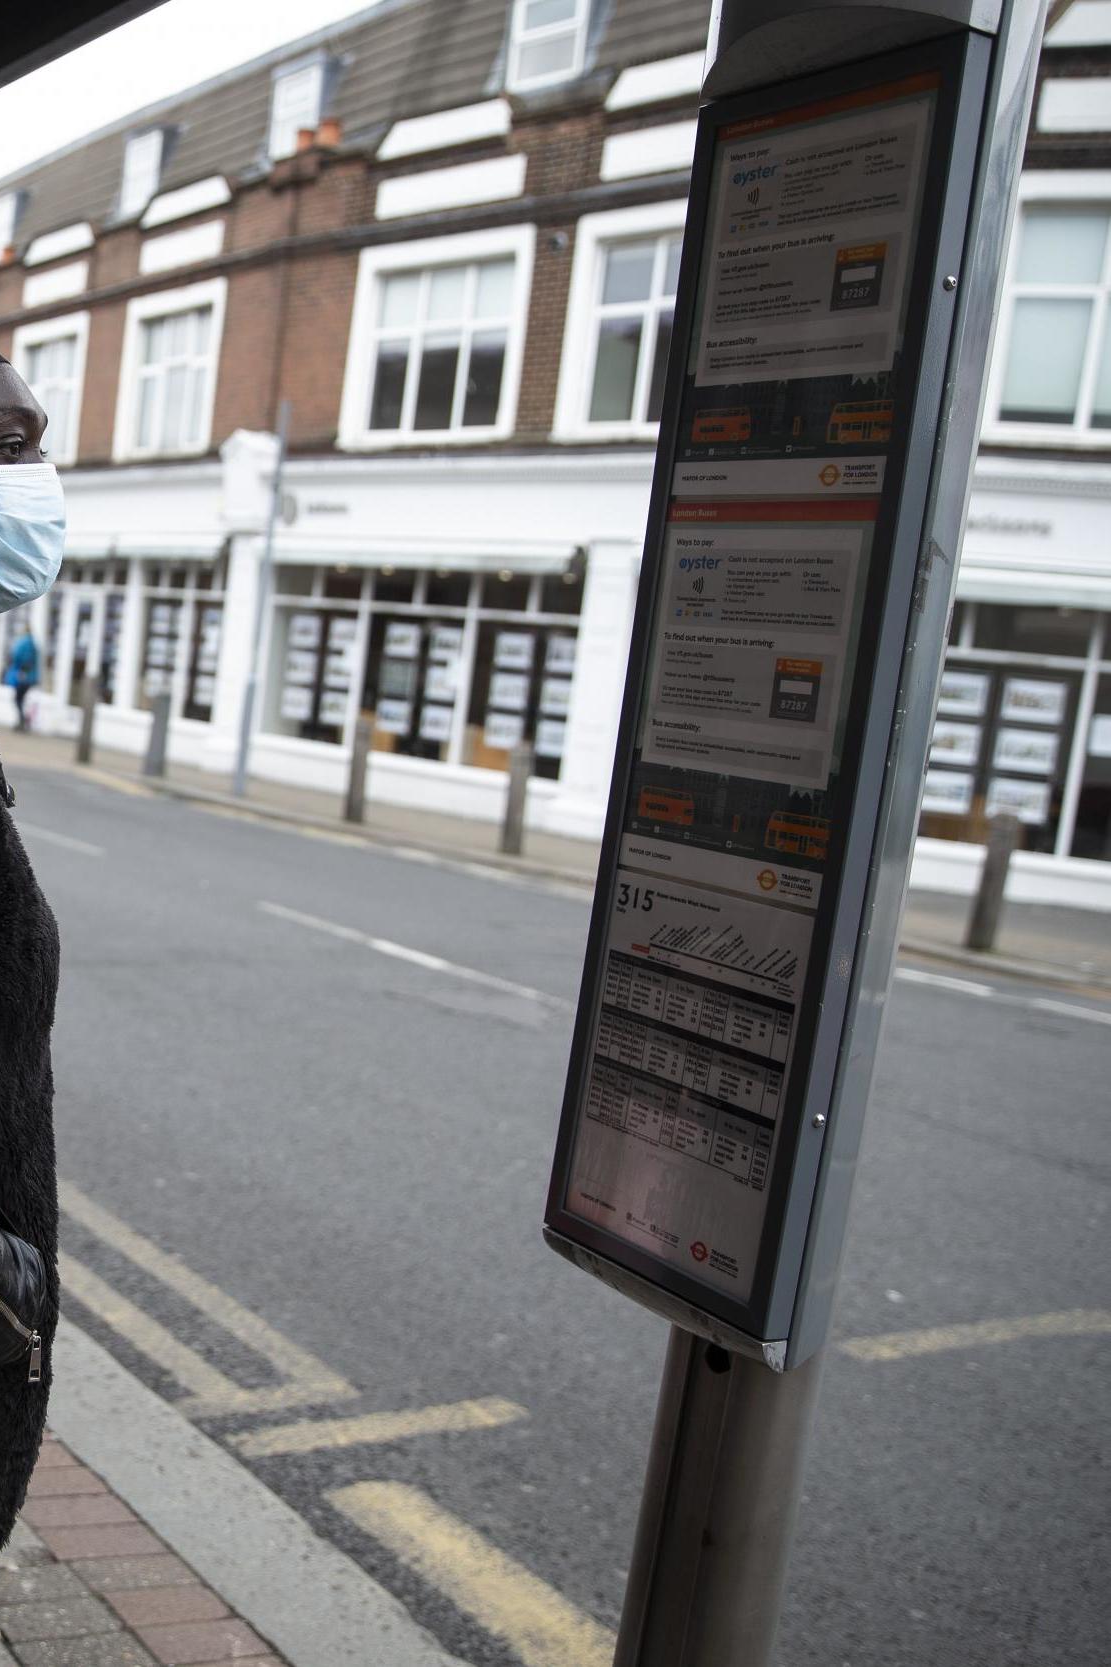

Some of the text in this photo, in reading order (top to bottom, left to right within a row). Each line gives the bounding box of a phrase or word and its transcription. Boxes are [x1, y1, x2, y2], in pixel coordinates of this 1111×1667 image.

[730, 150, 746, 162] Ways
[733, 163, 779, 186] oyster
[718, 251, 726, 260] To
[727, 249, 739, 259] find
[740, 247, 751, 257] out
[753, 244, 770, 255] when
[771, 243, 787, 252] your
[788, 239, 801, 250] bus
[809, 233, 835, 247] arriving:
[720, 336, 757, 348] accessibility:
[844, 464, 876, 472] TRANSPORT
[854, 471, 878, 479] LONDON
[673, 508, 718, 518] London Buses
[676, 538, 692, 547] Ways
[702, 539, 714, 548] pay:
[679, 556, 721, 573] oyster
[794, 556, 816, 564] London
[665, 632, 671, 642] To
[673, 632, 684, 643] find
[685, 633, 695, 644] out
[697, 634, 714, 645] when
[715, 636, 730, 646] your
[731, 636, 742, 646] bus
[749, 637, 775, 648] arriving:
[780, 702, 808, 714] 87287
[653, 719, 701, 733] Bus accessibility:
[791, 882, 813, 893] LONDON
[617, 883, 655, 912] 315
